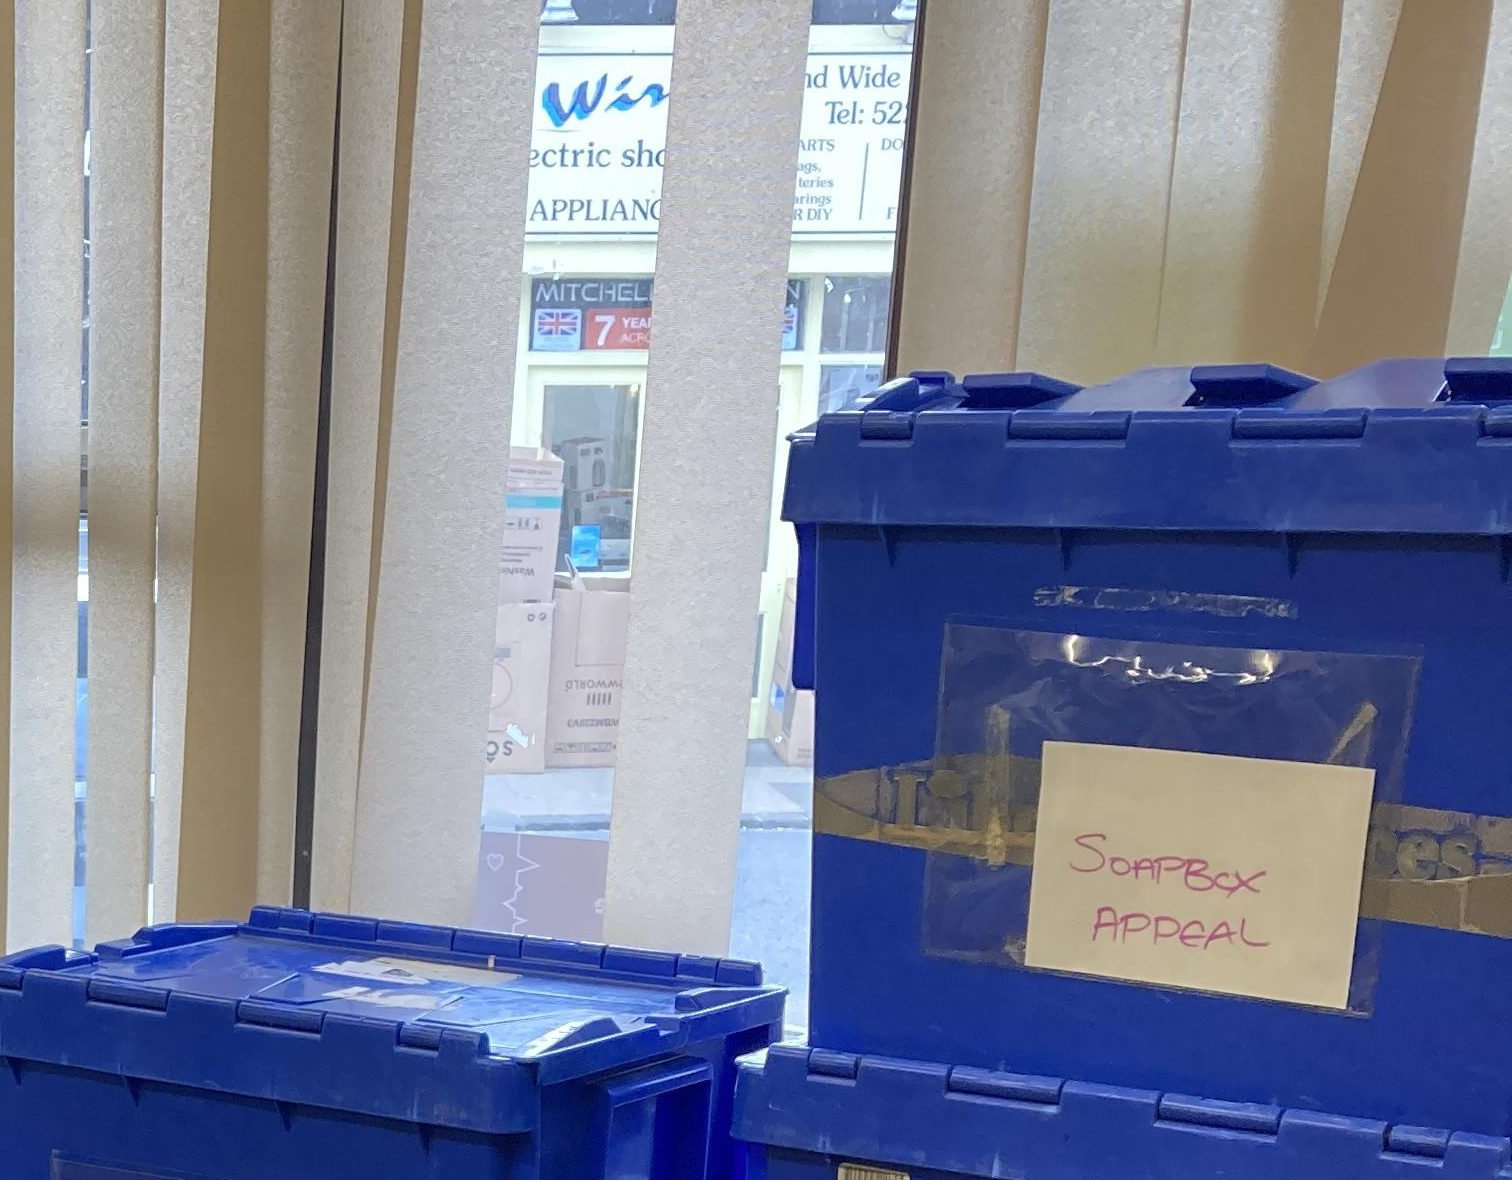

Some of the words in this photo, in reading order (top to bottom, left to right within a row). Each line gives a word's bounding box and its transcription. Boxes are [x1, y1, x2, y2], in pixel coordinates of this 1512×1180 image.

[838, 64, 901, 89] Wide
[824, 101, 865, 125] Tel:
[807, 208, 833, 220] DIY
[594, 314, 616, 346] 7
[1092, 906, 1271, 950] APPEAL
